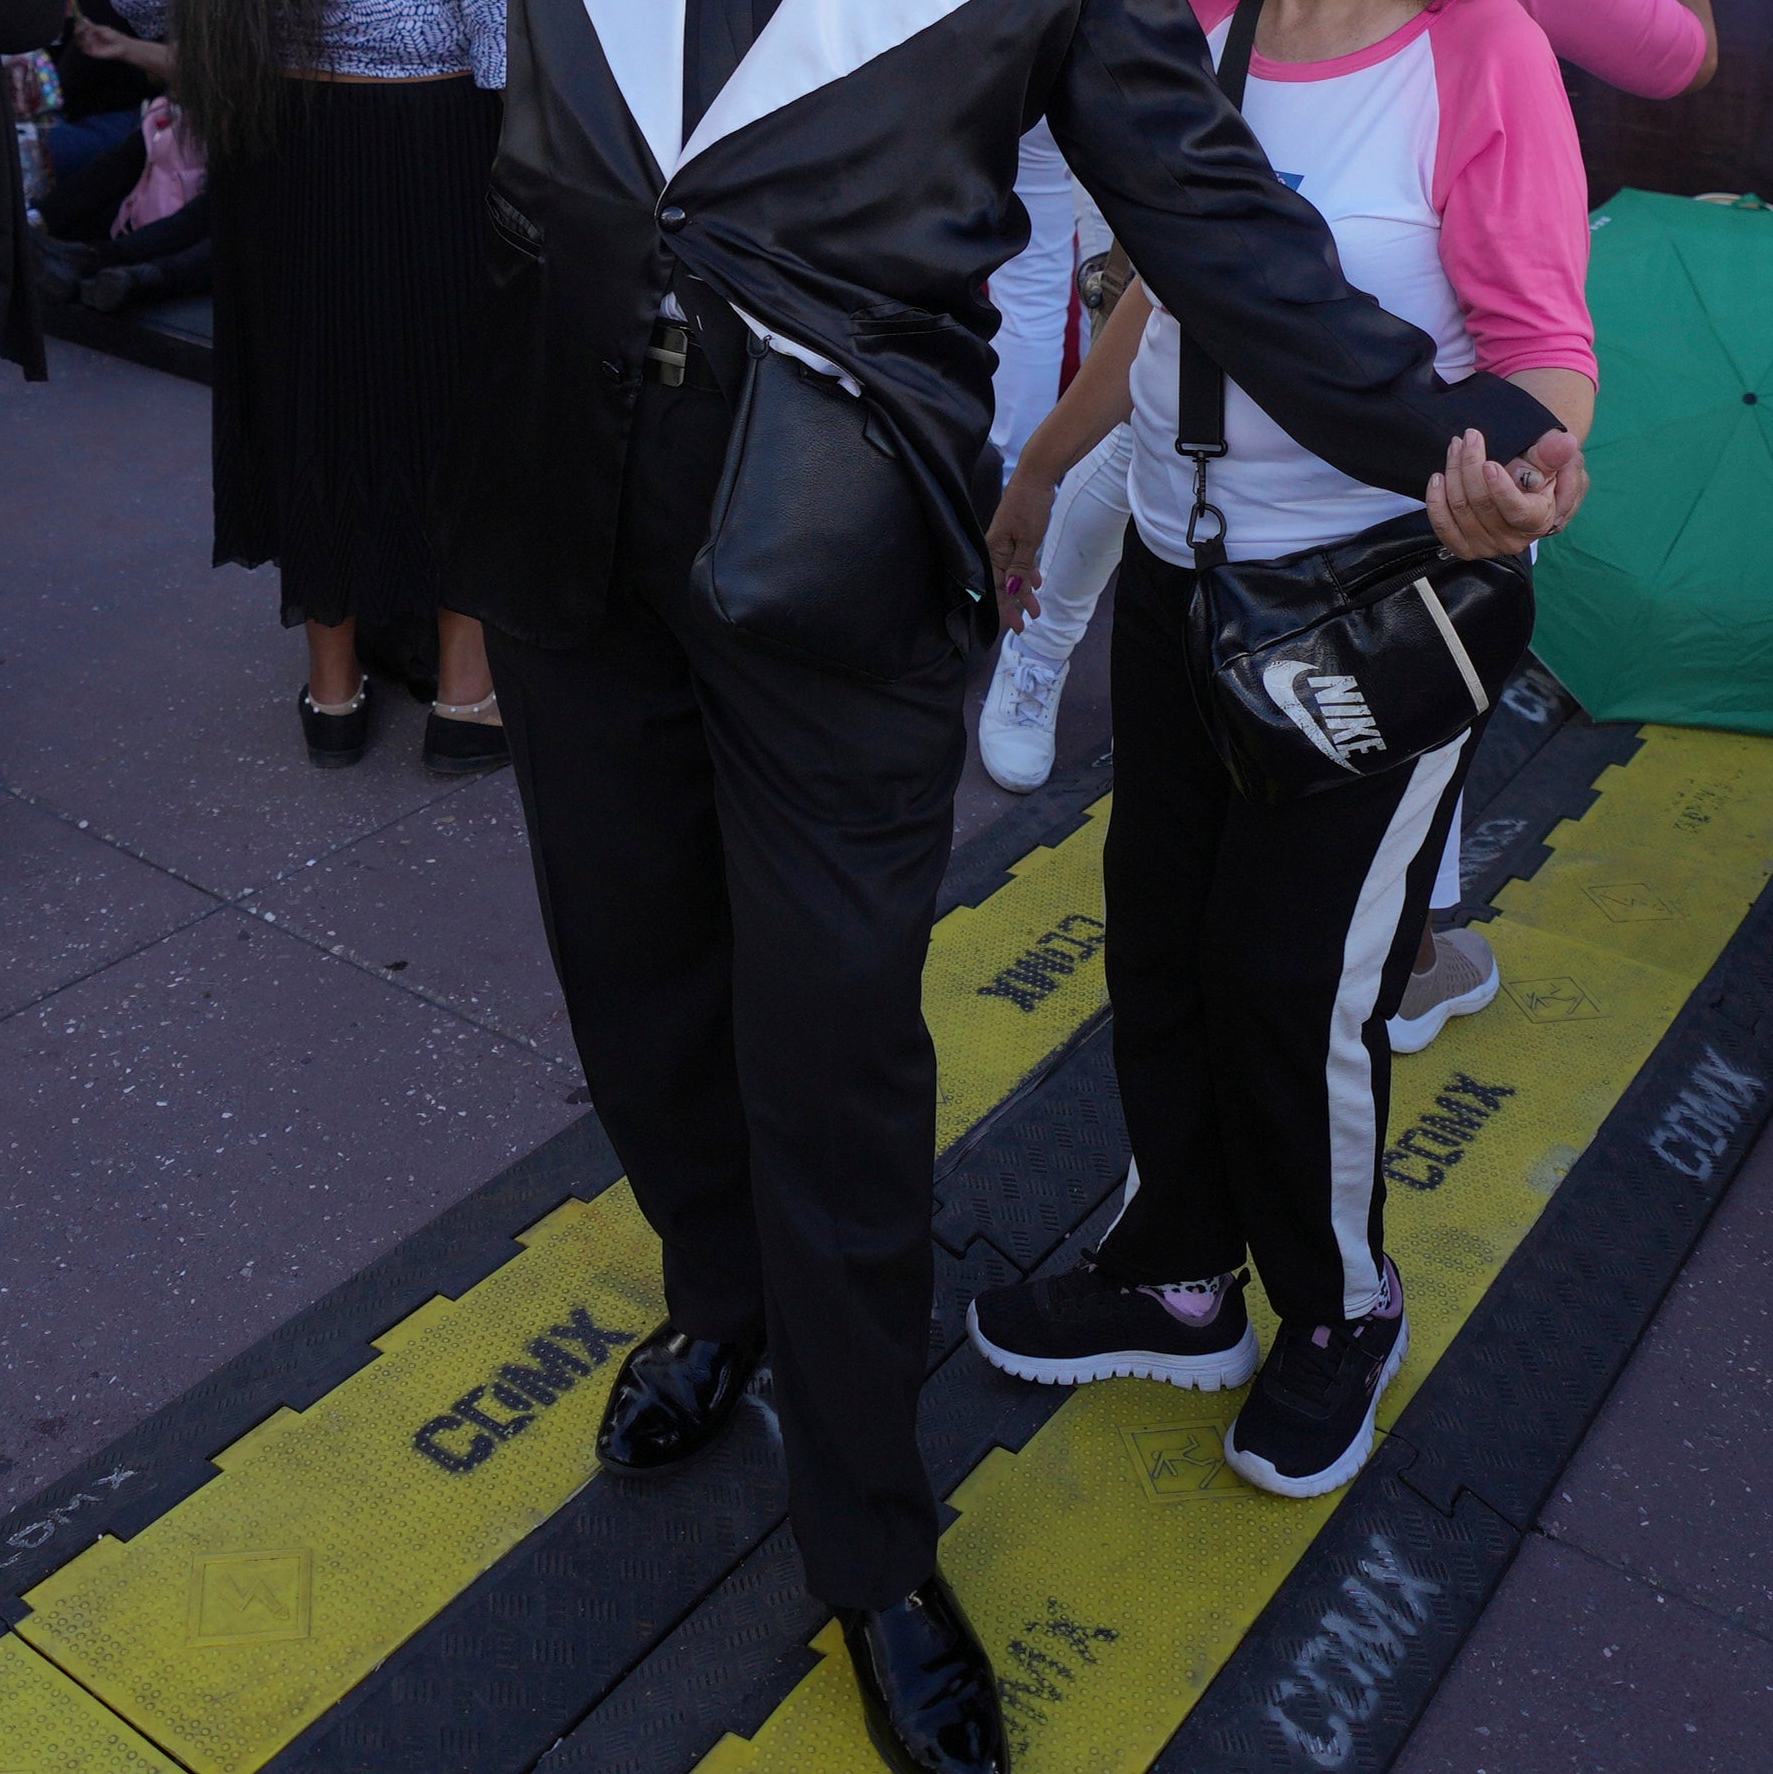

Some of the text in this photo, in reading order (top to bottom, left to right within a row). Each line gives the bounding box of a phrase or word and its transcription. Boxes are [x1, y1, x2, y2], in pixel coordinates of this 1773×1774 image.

[1307, 675, 1387, 760] NIKE
[1381, 1072, 1517, 1192] CDMX
[1648, 1044, 1764, 1181] CDMX
[413, 1306, 638, 1473] CDMX
[1266, 1534, 1442, 1766] CDMX
